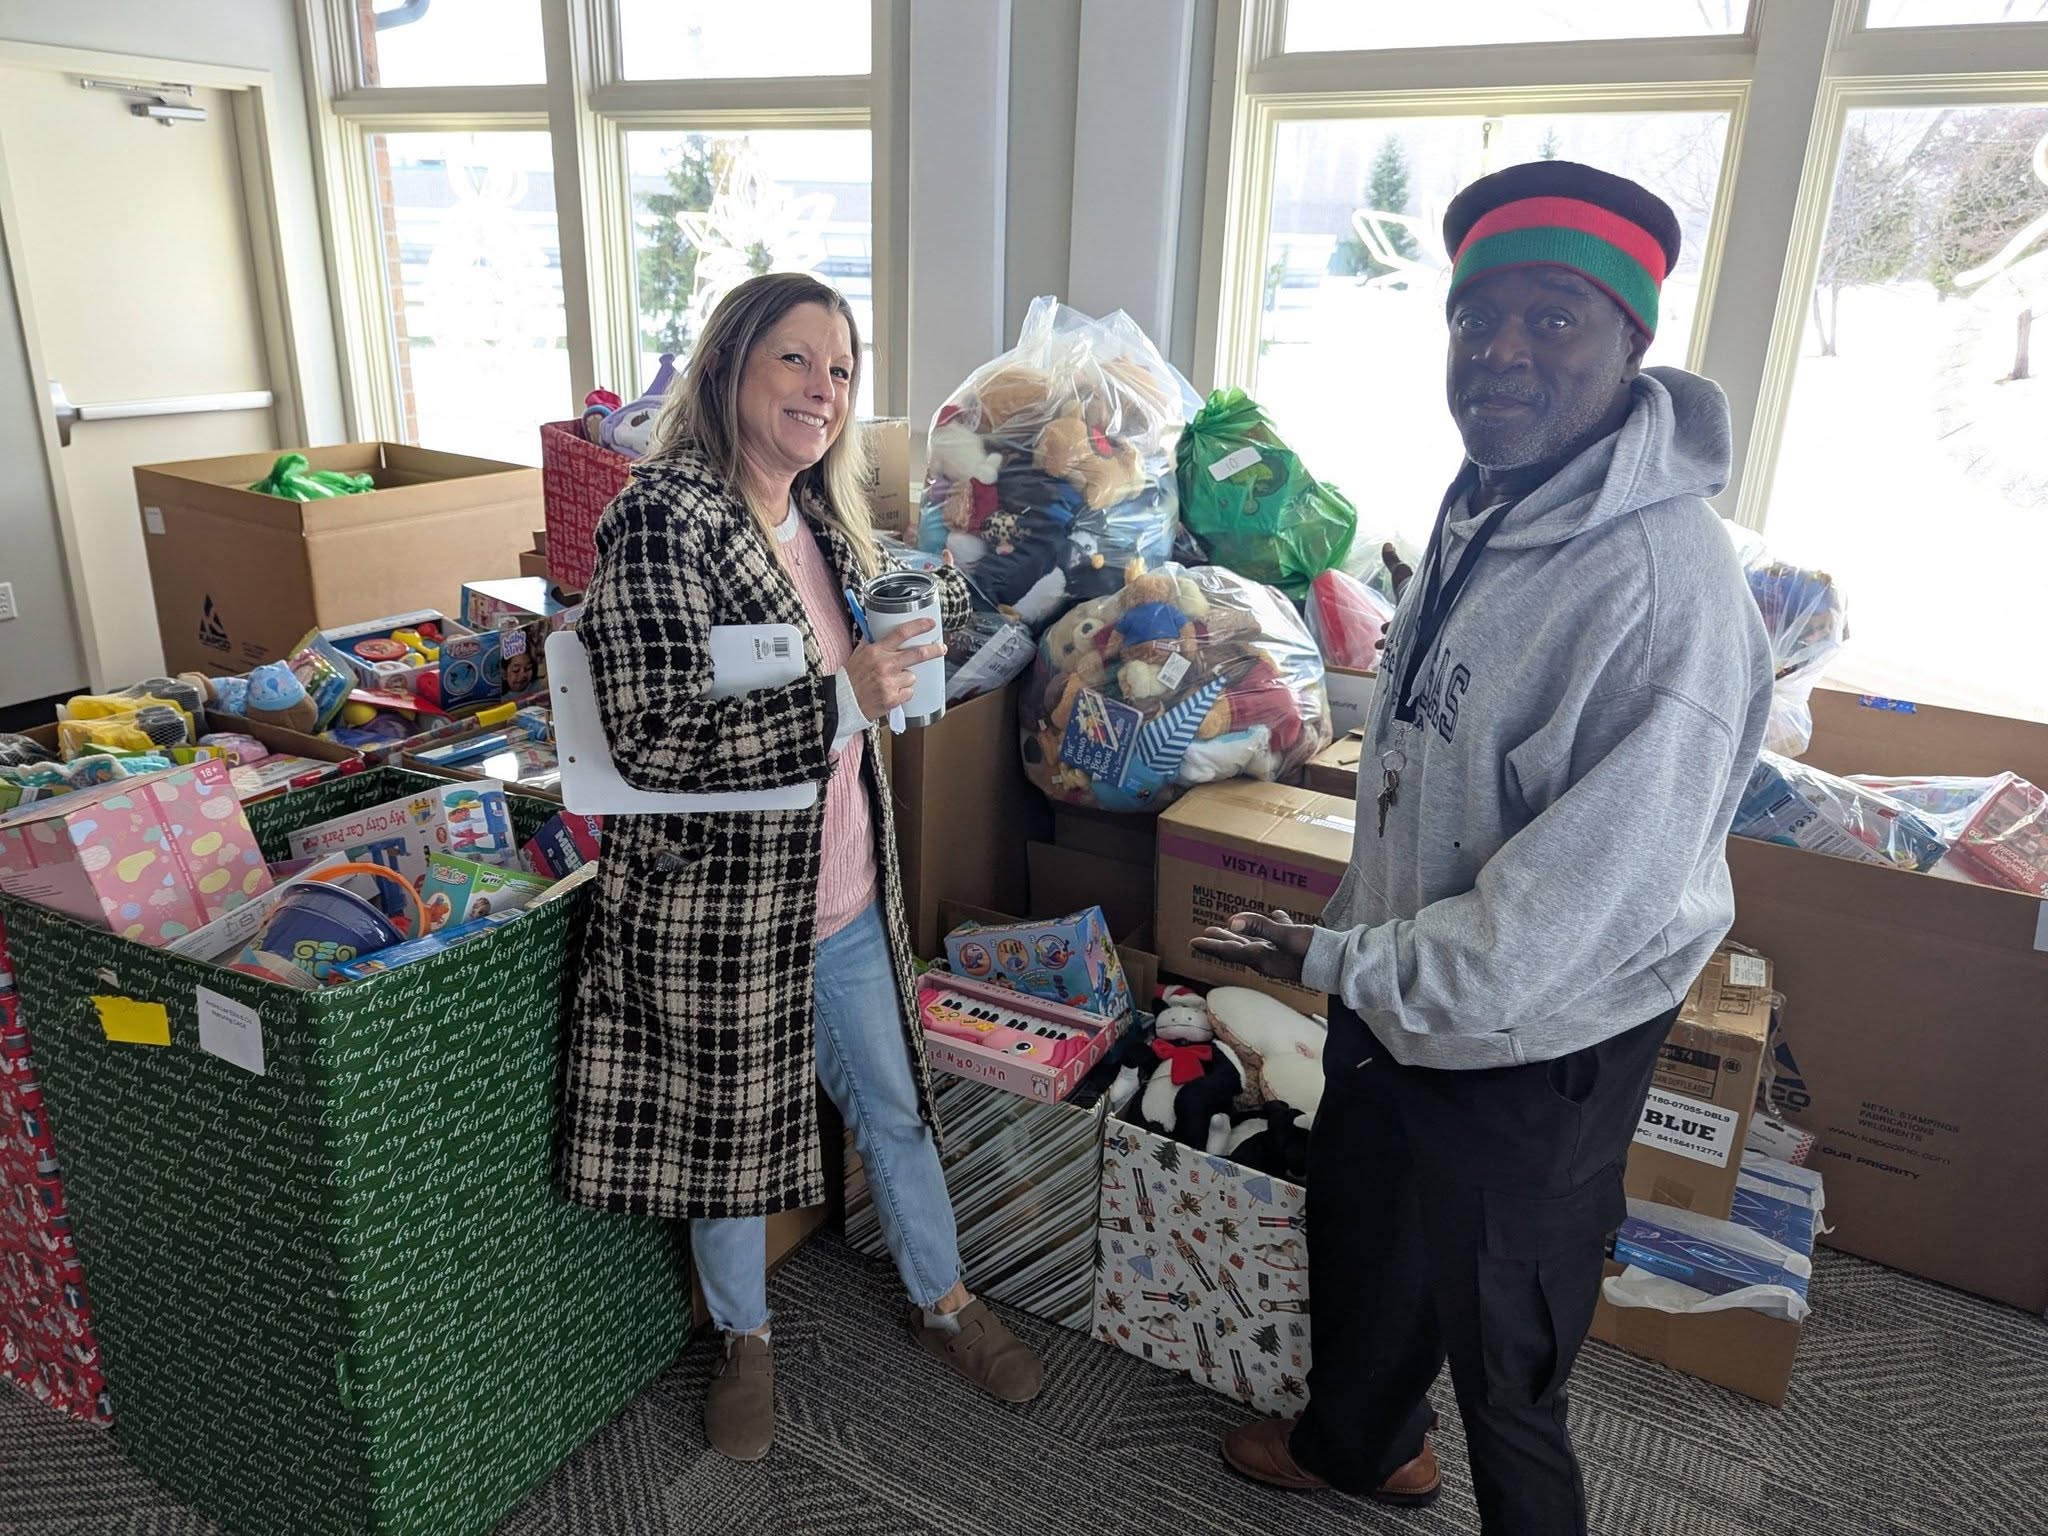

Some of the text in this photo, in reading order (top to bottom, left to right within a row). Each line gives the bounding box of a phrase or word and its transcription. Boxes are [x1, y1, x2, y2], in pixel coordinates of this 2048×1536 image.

[503, 631, 526, 648] baby
[503, 642, 526, 659] alive
[1065, 741, 1075, 757] THE
[1090, 751, 1102, 770] BED
[1100, 750, 1113, 774] BOOK
[200, 766, 219, 779] 18+
[365, 816, 388, 831] City
[389, 810, 407, 824] My
[321, 829, 345, 848] Park
[345, 823, 365, 837] Car
[1221, 853, 1308, 888] VISTA LITE
[1192, 884, 1265, 912] MULTICOLOR
[1192, 895, 1212, 910] LED
[947, 1051, 1006, 1081] UNICORN
[1643, 1109, 1716, 1141] BLUE
[1859, 1110, 1936, 1137] FABRICATIONS
[1900, 1111, 1960, 1133] STAMPINGS
[1636, 1128, 1652, 1137] PC:
[1823, 1146, 1921, 1180] OUR PRIORITY
